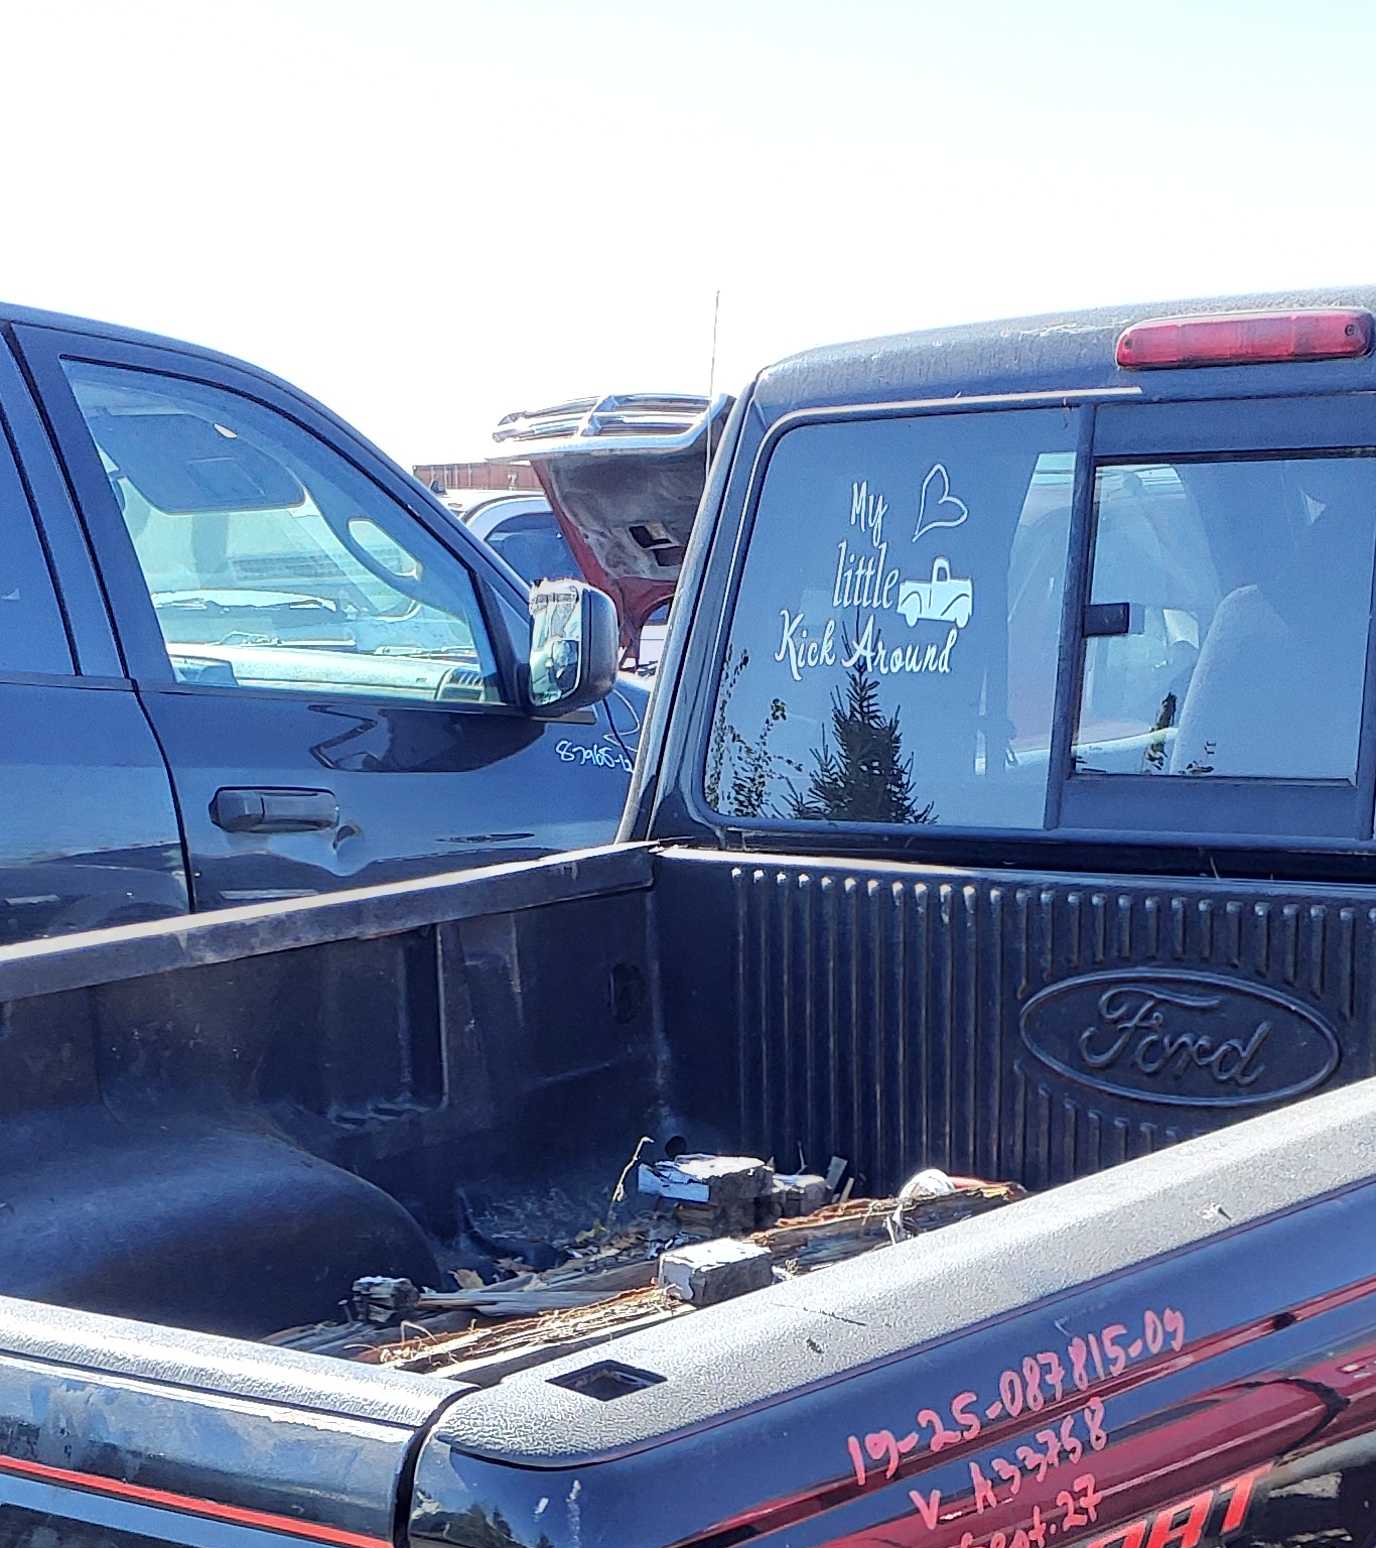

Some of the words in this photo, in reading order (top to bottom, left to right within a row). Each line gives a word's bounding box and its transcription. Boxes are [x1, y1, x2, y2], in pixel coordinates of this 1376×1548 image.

[850, 480, 888, 546] My
[832, 540, 899, 609] little
[774, 609, 836, 681] Kick
[840, 614, 958, 674] Around
[1079, 985, 1273, 1086] Ford
